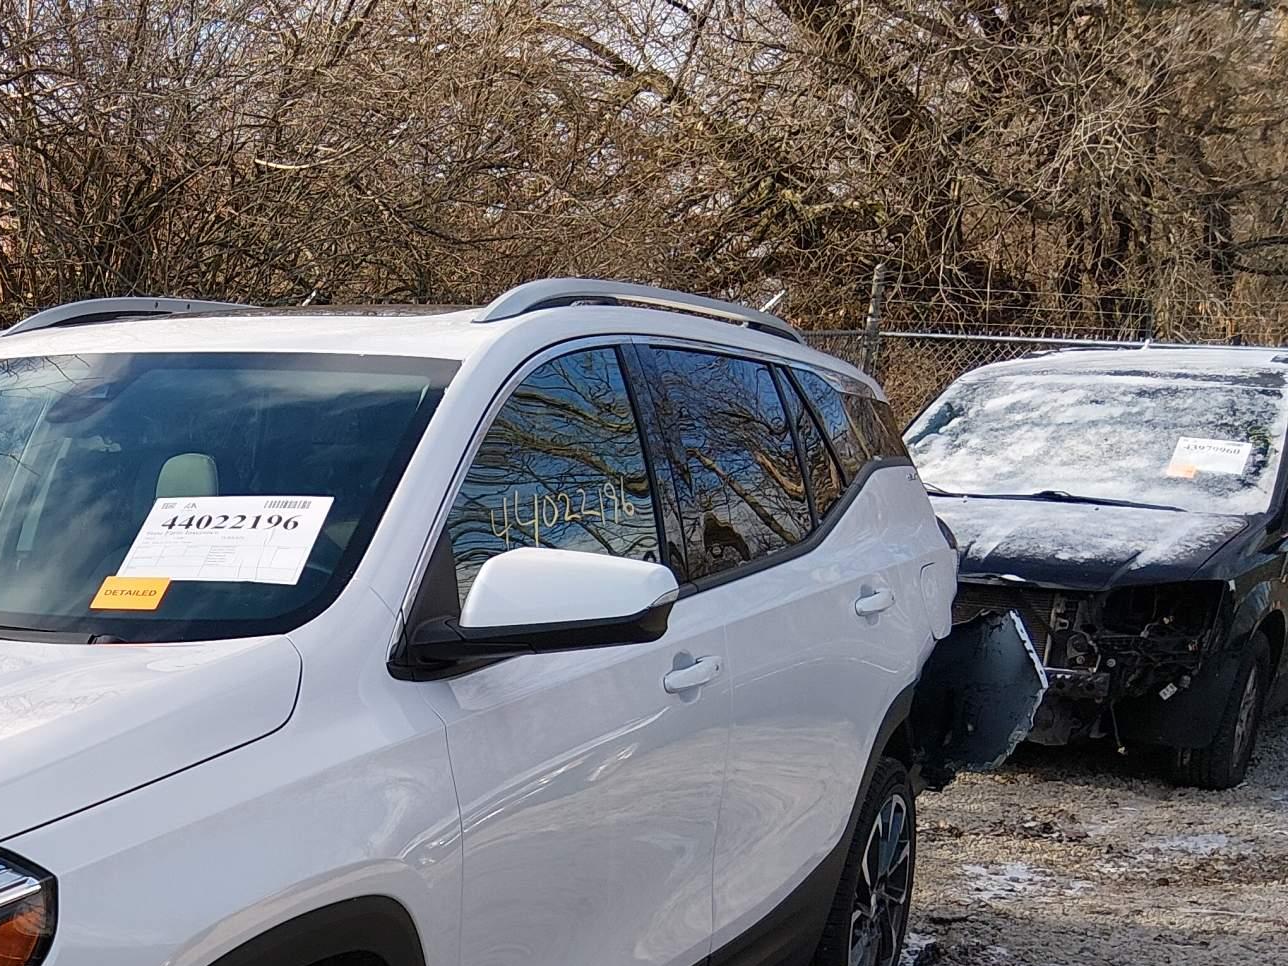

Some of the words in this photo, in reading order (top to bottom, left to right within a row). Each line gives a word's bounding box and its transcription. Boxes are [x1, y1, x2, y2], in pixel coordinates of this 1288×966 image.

[490, 476, 635, 551] 44022196
[161, 514, 300, 531] 44022196
[103, 589, 158, 597] DETAILED
